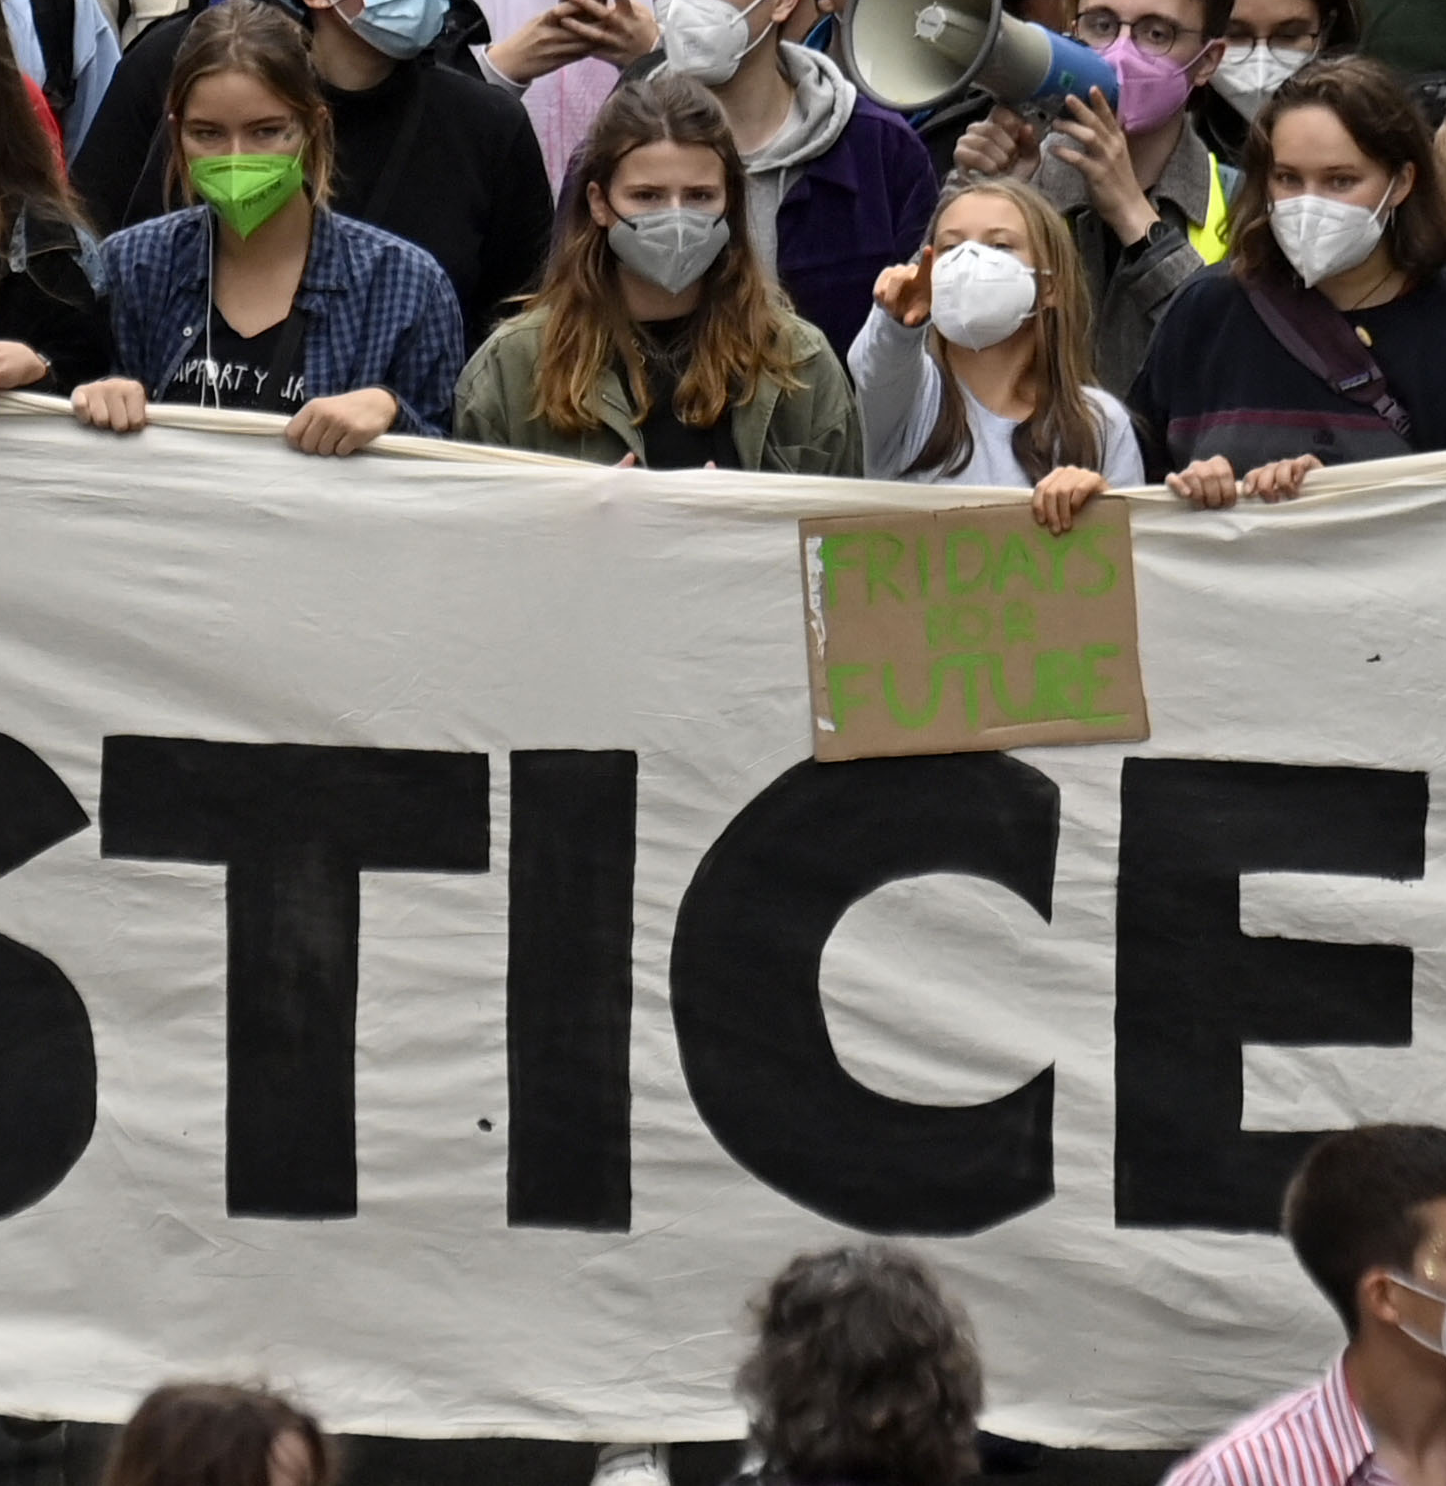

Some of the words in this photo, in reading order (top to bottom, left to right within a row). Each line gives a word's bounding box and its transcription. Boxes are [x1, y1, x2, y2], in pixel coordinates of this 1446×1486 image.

[820, 524, 1124, 608] FRIDAYS
[924, 600, 1038, 650] FOR
[826, 643, 1130, 733] FUTURE
